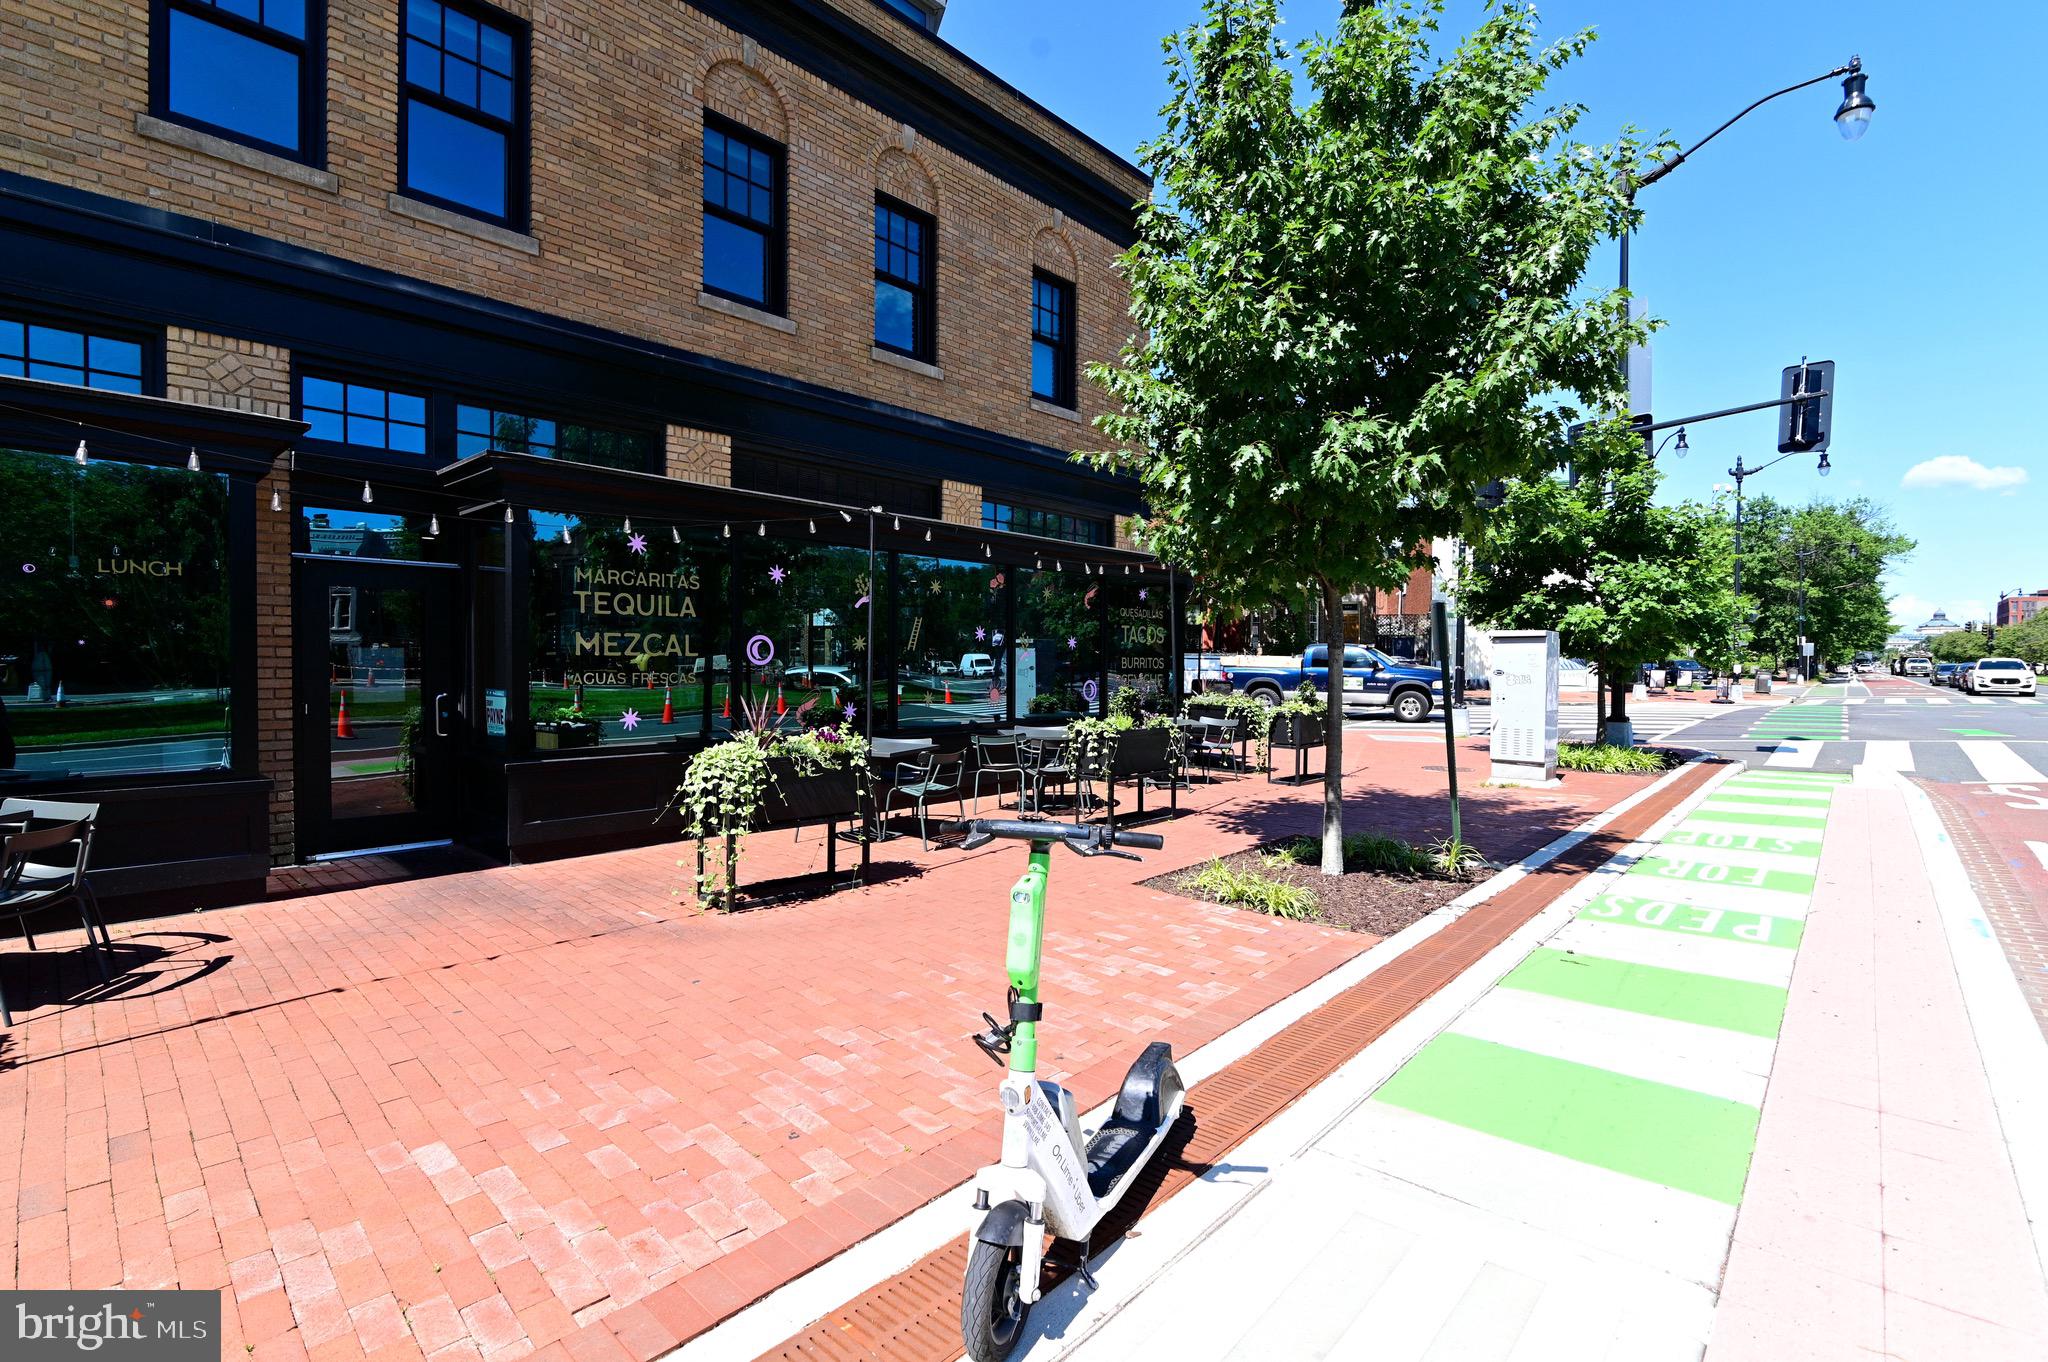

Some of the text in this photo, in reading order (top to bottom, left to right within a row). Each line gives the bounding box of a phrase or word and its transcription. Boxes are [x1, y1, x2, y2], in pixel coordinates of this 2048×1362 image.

[97, 558, 183, 577] LUNCH
[576, 567, 700, 590] MARGARITAS
[572, 590, 697, 618] TEQUILA
[1120, 607, 1164, 620] QUESADILLAS
[575, 631, 699, 657] MEZCAL
[1121, 624, 1165, 644] TACOS
[1121, 657, 1165, 669] BURRITOS
[573, 672, 697, 685] AGUAS FRESCAS
[1658, 859, 1769, 887] FOR
[1590, 894, 1773, 943] PEDS
